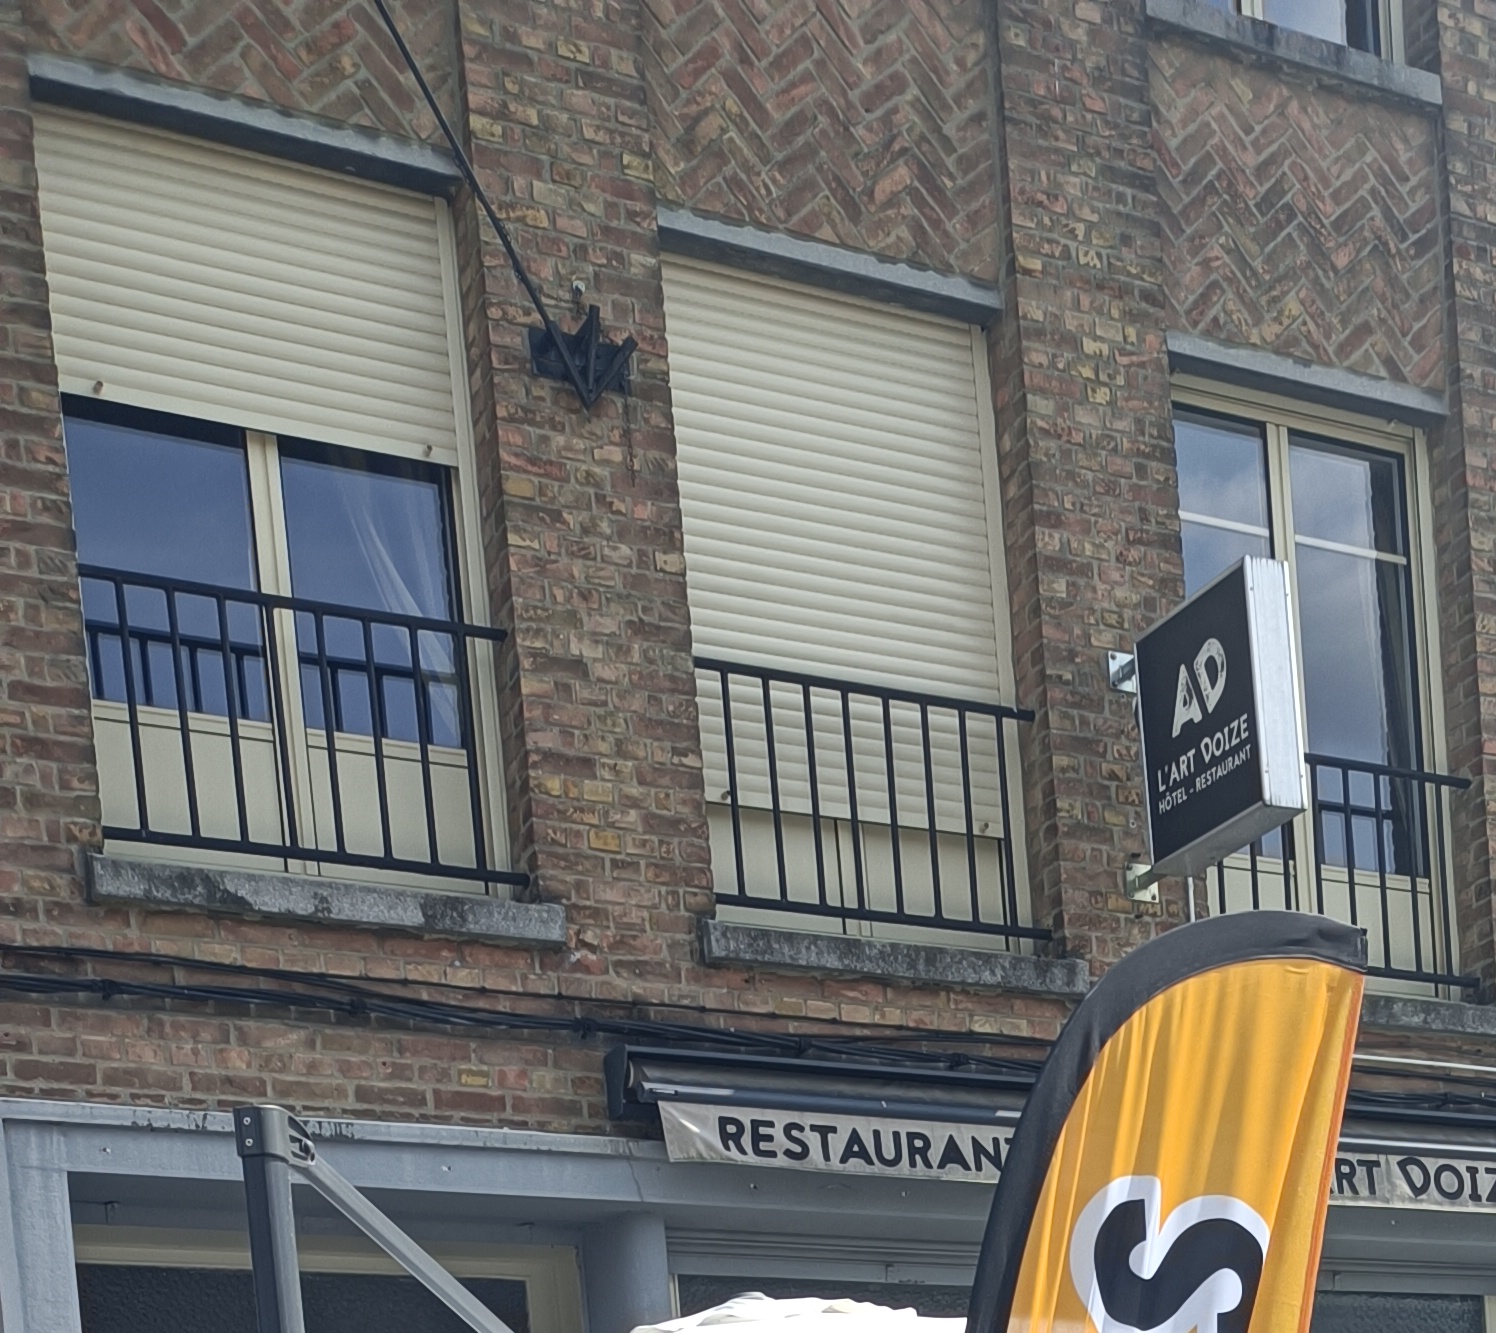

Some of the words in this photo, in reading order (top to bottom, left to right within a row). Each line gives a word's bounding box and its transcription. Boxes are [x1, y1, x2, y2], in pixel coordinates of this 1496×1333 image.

[1172, 638, 1227, 738] AD
[1158, 748, 1196, 793] L'ART
[1200, 713, 1249, 764] DOIZE
[1195, 744, 1251, 793] RESTAURANT
[718, 1115, 1013, 1173] RESTAURAN
[1331, 1157, 1381, 1196] RT
